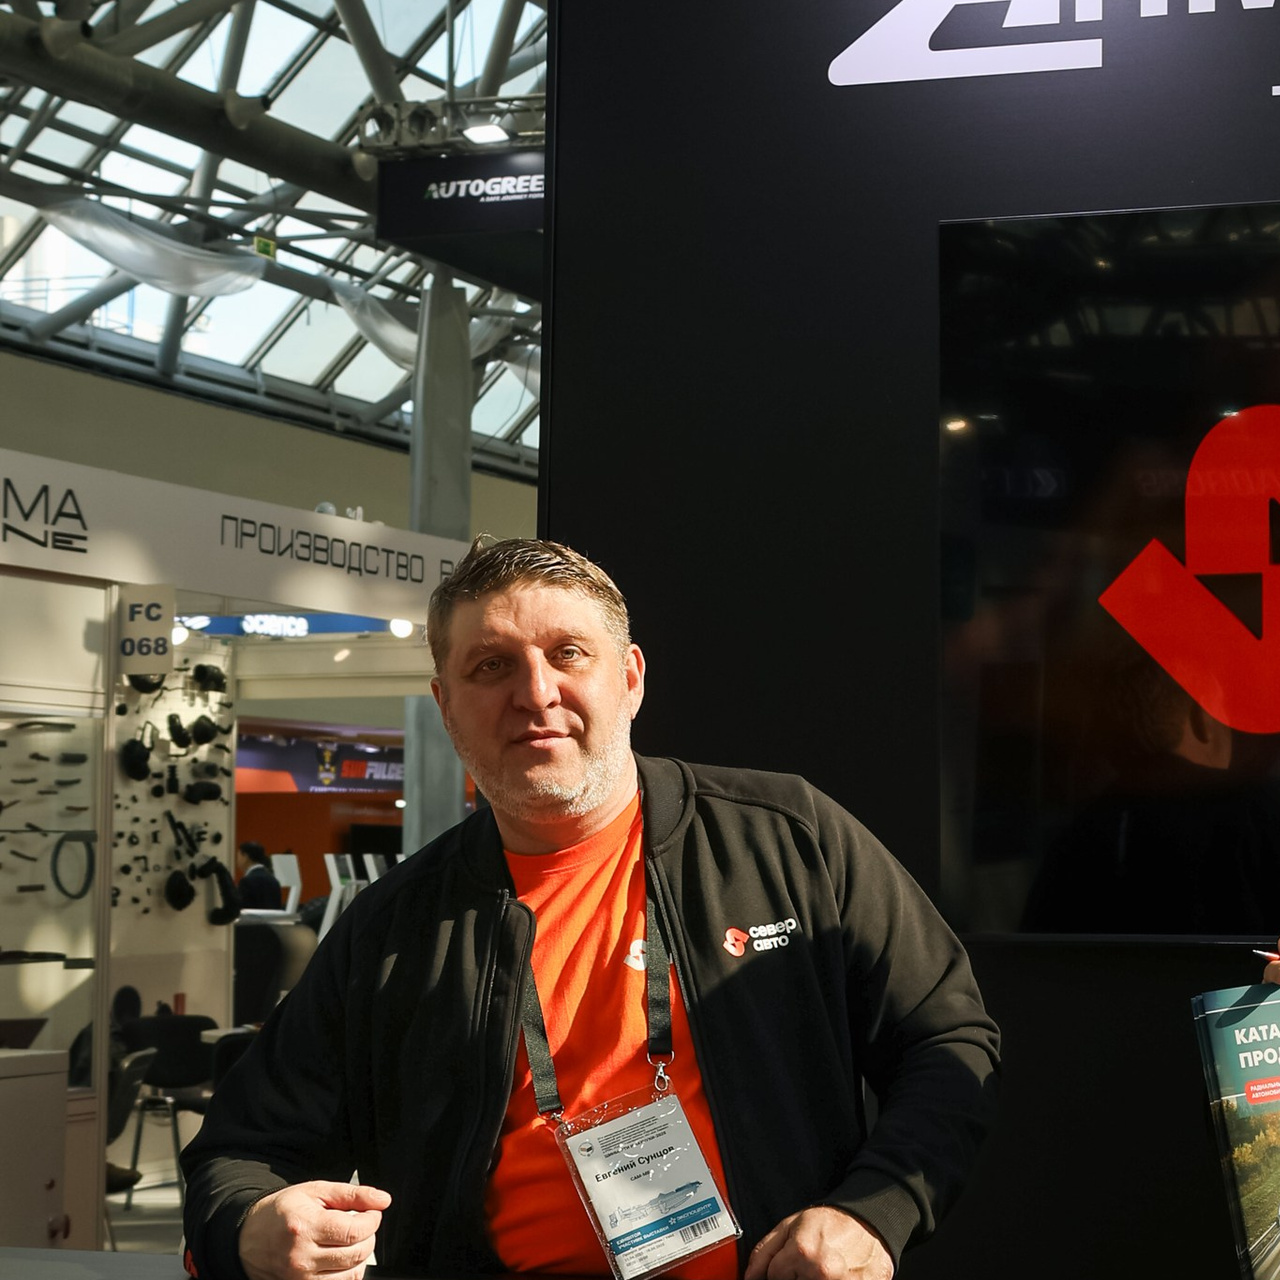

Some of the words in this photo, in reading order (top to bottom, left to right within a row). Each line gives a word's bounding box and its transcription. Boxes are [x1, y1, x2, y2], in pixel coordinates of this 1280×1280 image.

[424, 174, 545, 199] AUTOGREE
[220, 513, 425, 584] ПРОИЗВОДСТВО
[128, 603, 163, 622] FC
[120, 636, 169, 658] 068
[749, 917, 798, 938] север
[753, 934, 790, 952] авто
[595, 1160, 637, 1183] Евгений
[637, 1145, 676, 1165] Сунцов
